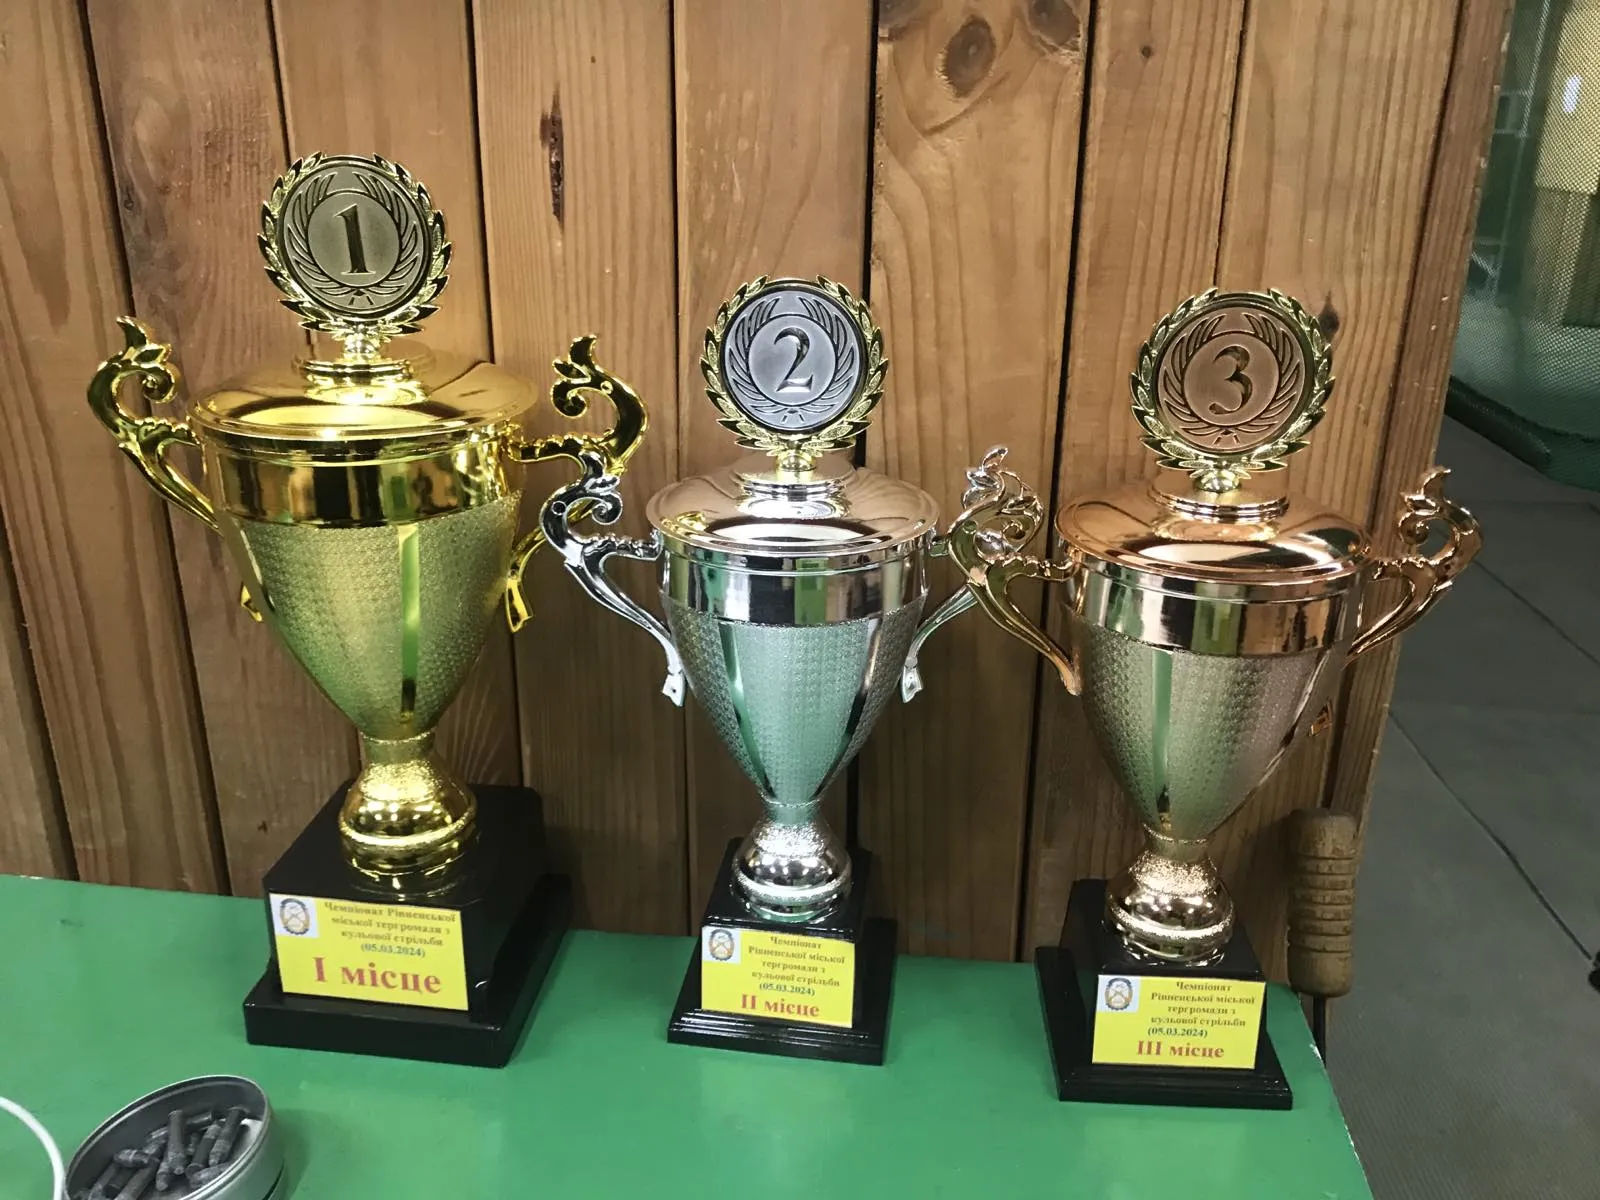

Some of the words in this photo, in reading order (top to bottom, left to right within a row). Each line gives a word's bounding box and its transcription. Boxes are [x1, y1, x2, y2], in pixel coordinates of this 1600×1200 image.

[333, 203, 376, 276] 1
[773, 326, 815, 393] 2
[1208, 343, 1253, 415] 3
[324, 901, 384, 917] Чемпіонат
[387, 908, 456, 923] Рівненської
[331, 916, 373, 928] міської
[341, 930, 391, 942] кульової
[393, 935, 443, 947] стрільби
[770, 935, 822, 949] Чемпіонат
[361, 943, 426, 958] (05.03.2024)
[748, 945, 806, 960] Рівненської
[809, 953, 846, 964] міської
[340, 961, 442, 995] місце
[751, 971, 795, 982] кульової
[796, 976, 840, 987] стрільби
[1176, 980, 1233, 992] Чемпіонат
[759, 983, 816, 997] (05.03.2024)
[1150, 991, 1213, 1003] Рівненської
[1215, 995, 1256, 1005] міської
[764, 998, 820, 1018] місце
[1150, 1016, 1197, 1027] кульової
[1199, 1017, 1247, 1028] стрільби
[1147, 1027, 1209, 1038] (05.03.2024)
[1168, 1042, 1225, 1059] місце
